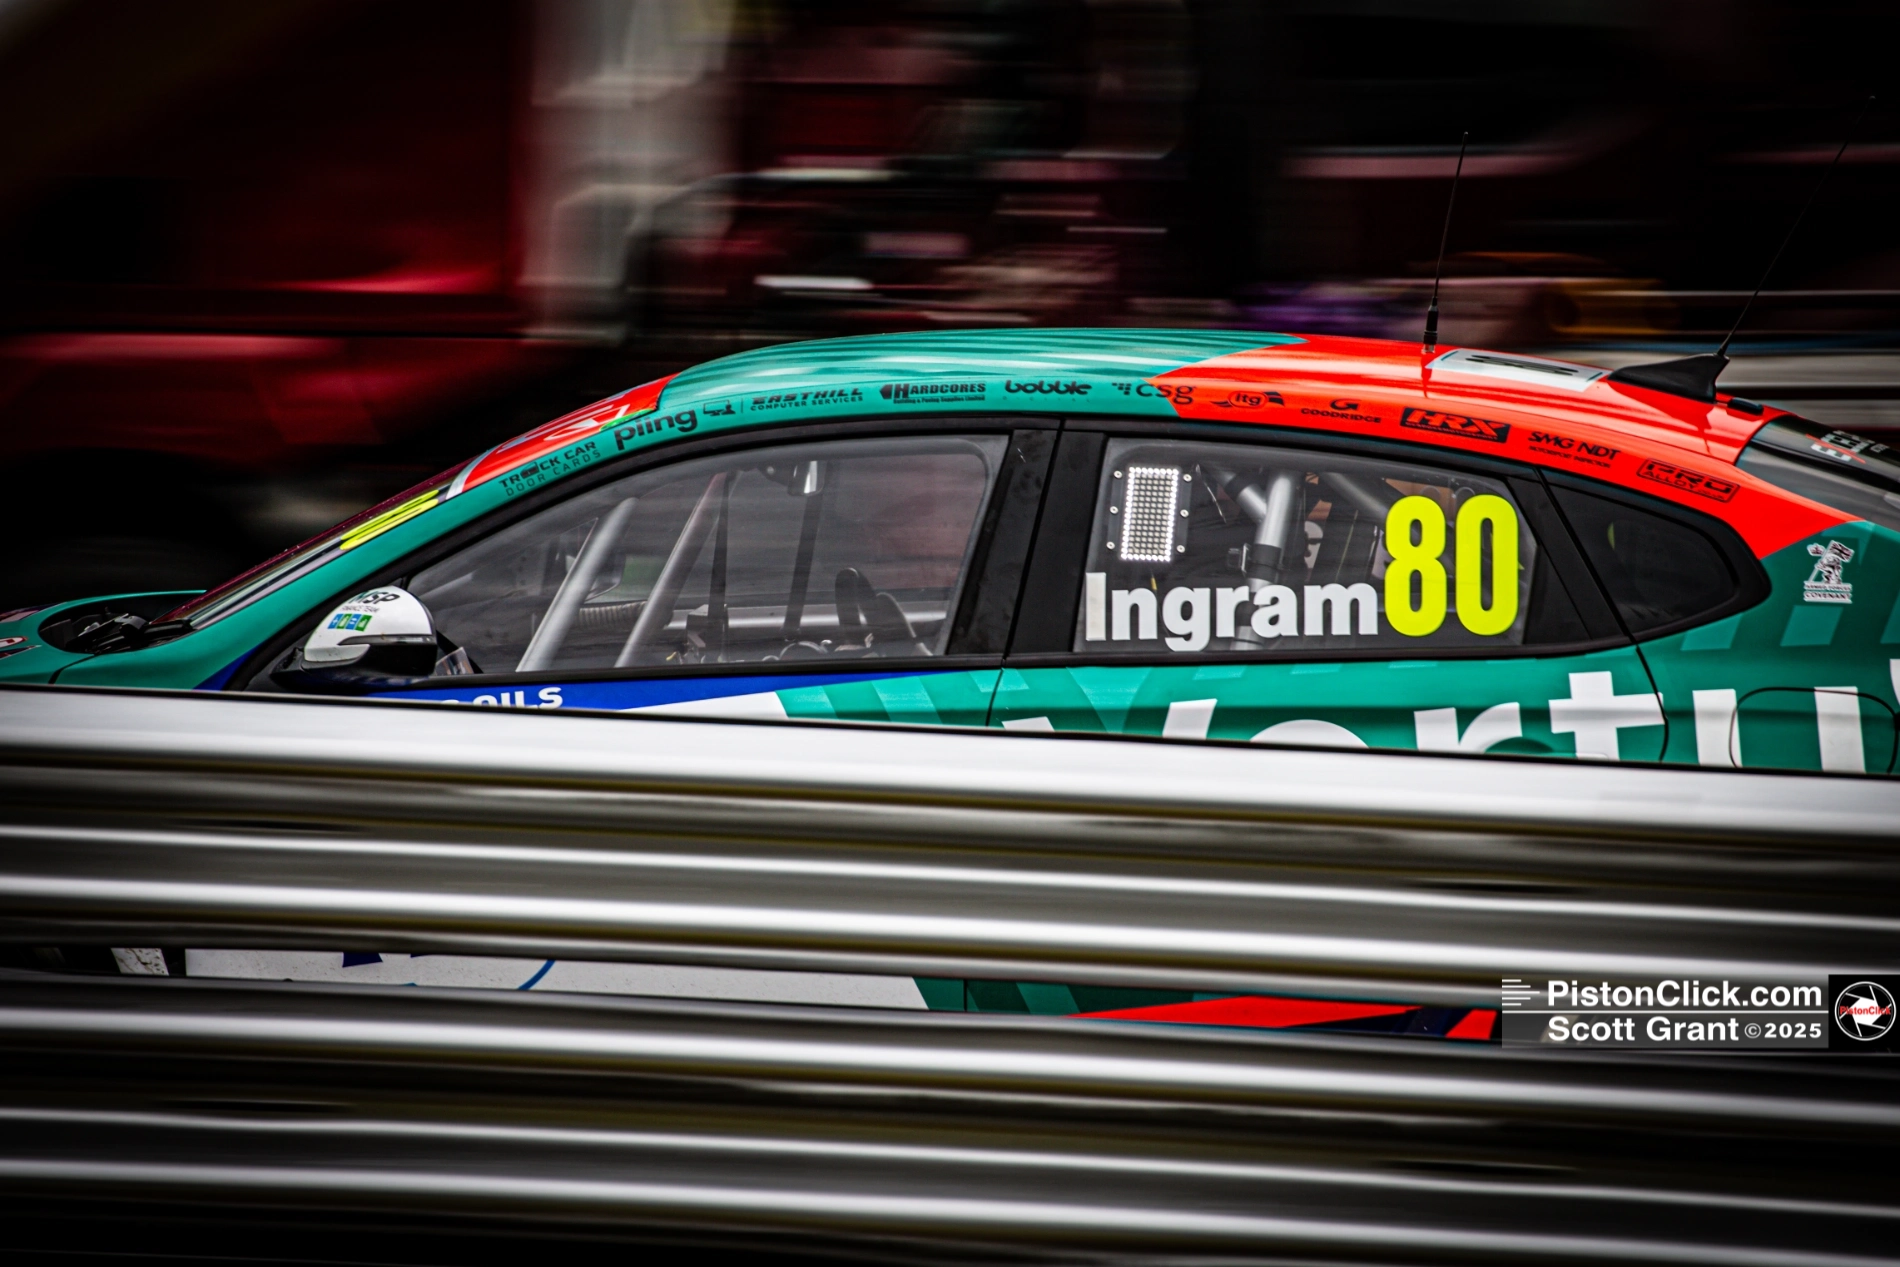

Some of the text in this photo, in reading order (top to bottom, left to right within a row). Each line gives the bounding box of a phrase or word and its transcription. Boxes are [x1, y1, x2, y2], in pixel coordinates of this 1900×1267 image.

[752, 388, 863, 405] EASTHILL
[894, 383, 986, 399] HARDCORES
[1005, 380, 1092, 395] bobble
[1135, 383, 1196, 405] csg
[750, 395, 863, 411] COMPUTER SERVICES
[614, 410, 698, 451] piing
[1406, 409, 1506, 437] HRX
[563, 441, 596, 460] CAR
[1528, 431, 1621, 460] SMG NDT
[506, 450, 601, 496] DOOR CARDS
[1086, 494, 1518, 651] Ingram 80
